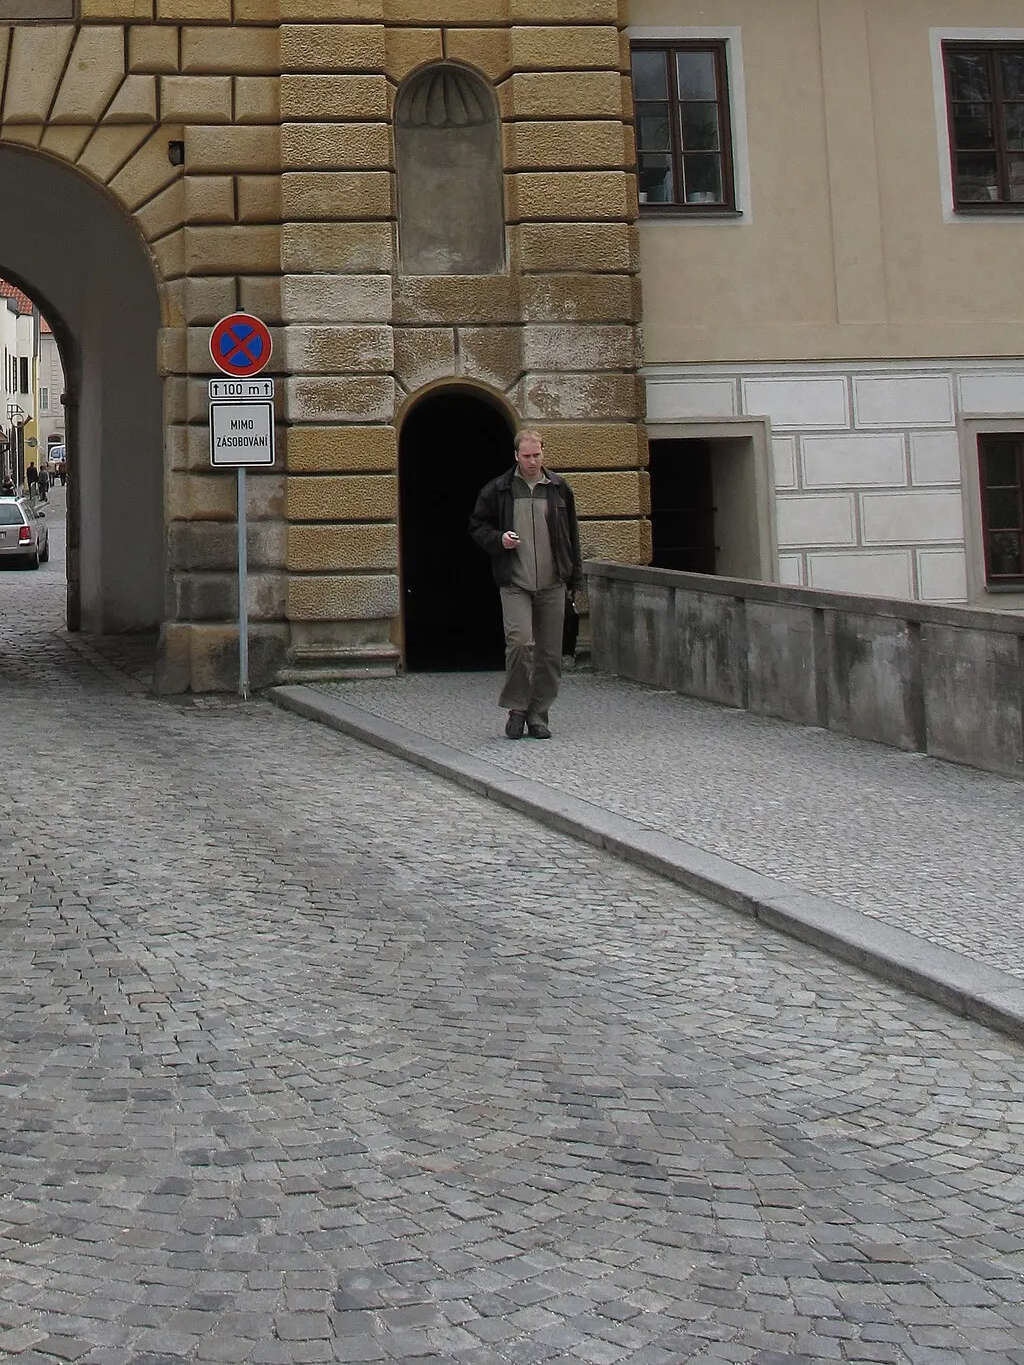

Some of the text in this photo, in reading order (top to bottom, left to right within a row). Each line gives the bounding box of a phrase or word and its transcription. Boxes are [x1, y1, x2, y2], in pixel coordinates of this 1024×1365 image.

[223, 383, 260, 395] 100 m
[230, 419, 254, 430] MIMO
[216, 434, 268, 447] ZÁSOBOVÁNÍ
